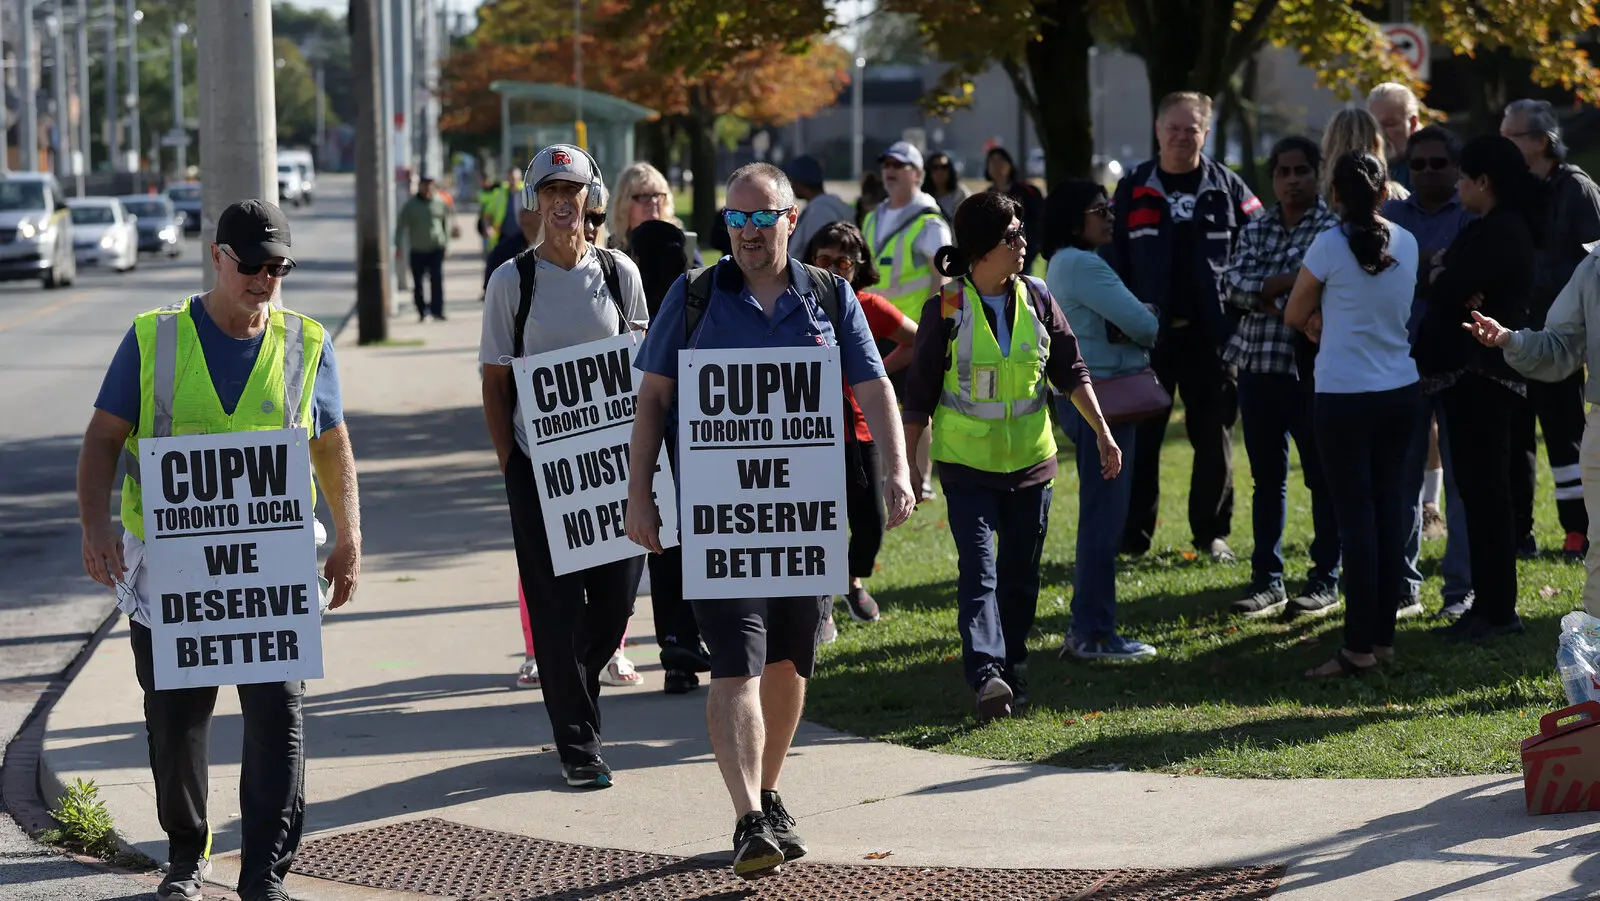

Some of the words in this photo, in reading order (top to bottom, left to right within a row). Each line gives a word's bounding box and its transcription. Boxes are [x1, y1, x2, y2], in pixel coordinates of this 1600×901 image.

[532, 348, 633, 413] CUPW
[699, 361, 822, 416] CUPW
[532, 405, 600, 439] TORONTO
[604, 394, 638, 422] LOCA
[689, 418, 774, 443] TORONTO
[781, 416, 835, 441] LOCAL
[161, 444, 288, 504] CUPW
[541, 458, 576, 500] NO
[575, 442, 662, 491] JUSTI
[736, 458, 790, 490] WE
[153, 503, 240, 532] TORONTO
[247, 499, 304, 525] LOCAL
[562, 508, 596, 550] NO
[692, 500, 838, 536] DESERVE
[203, 542, 259, 577] WE
[705, 545, 826, 580] BETTER
[160, 583, 310, 625] DESERVE
[175, 629, 300, 669] BETTER
